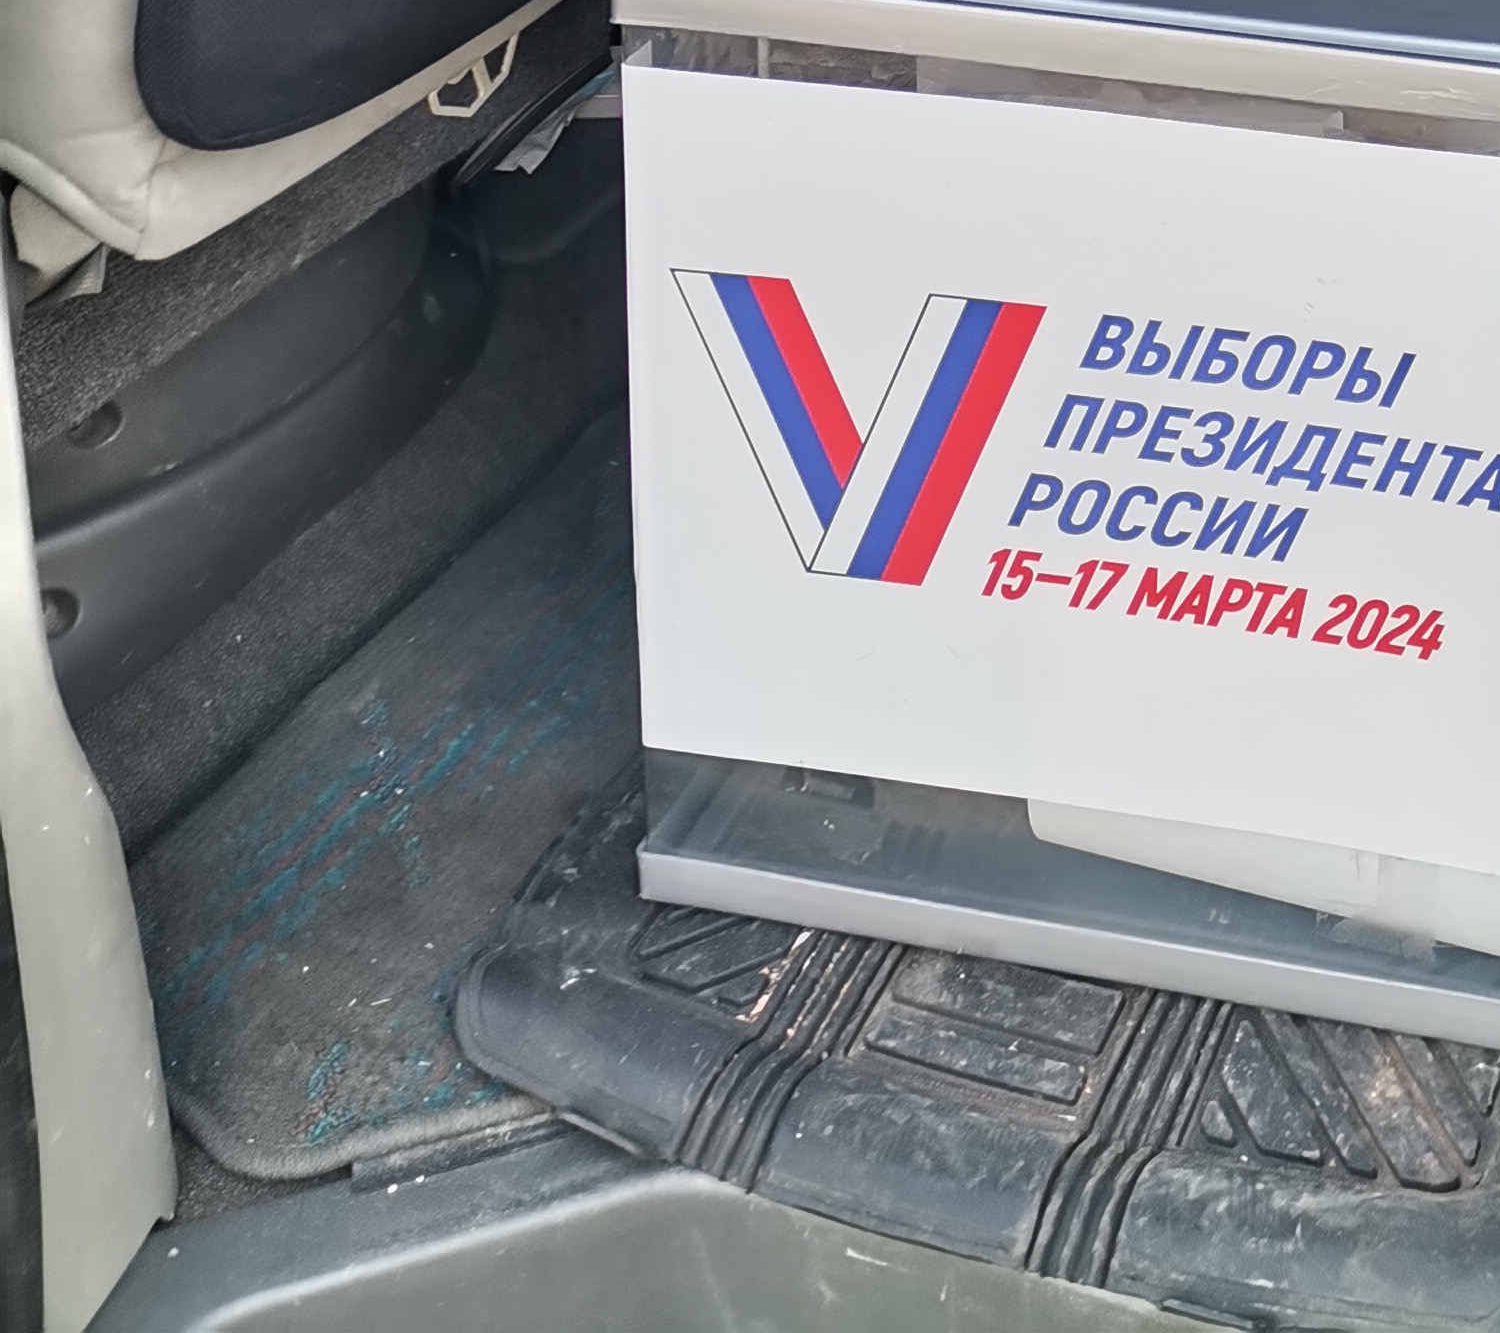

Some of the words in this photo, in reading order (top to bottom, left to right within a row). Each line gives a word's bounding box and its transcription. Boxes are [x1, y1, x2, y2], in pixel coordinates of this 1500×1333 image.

[1080, 315, 1416, 409] ВЫБОРЫ
[1008, 473, 1308, 563] РОССИИ
[1125, 565, 1309, 640] МАРТА
[1310, 593, 1446, 662] 2024
